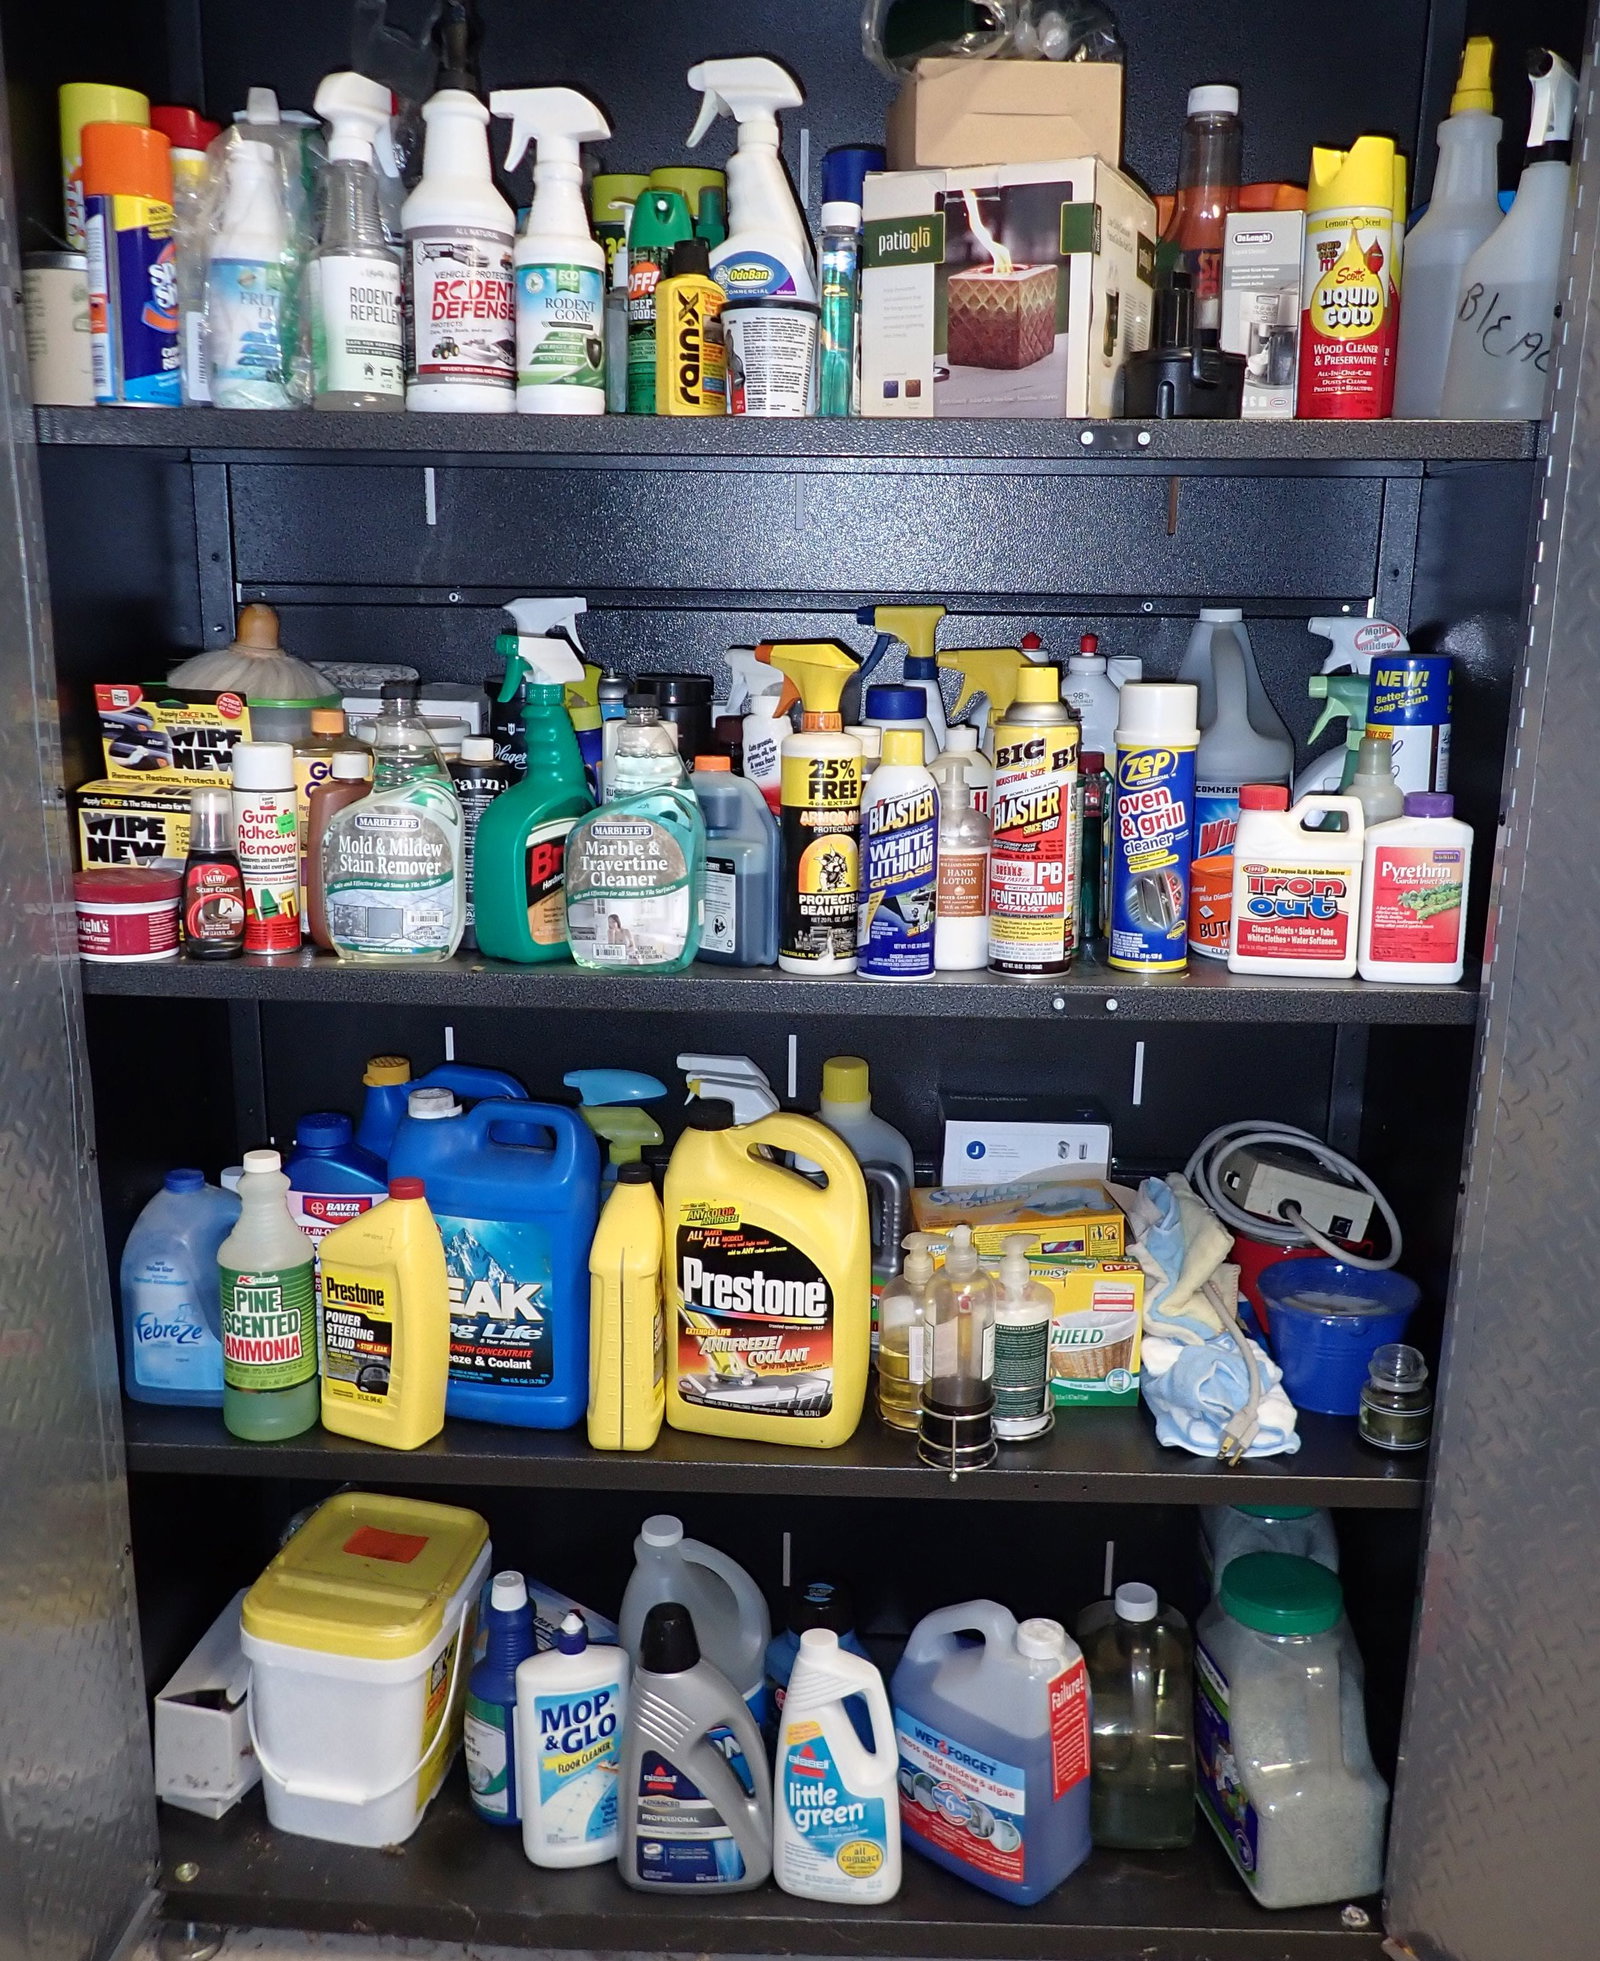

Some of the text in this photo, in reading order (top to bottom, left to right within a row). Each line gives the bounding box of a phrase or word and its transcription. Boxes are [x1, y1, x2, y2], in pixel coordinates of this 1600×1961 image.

[1325, 218, 1381, 229] Lemon Scent
[470, 229, 499, 240] NATURAL
[435, 270, 470, 279] VEHICLE
[729, 268, 768, 281] OdoBan
[350, 286, 393, 309] RODENT
[433, 280, 515, 301] RODENT
[1318, 287, 1379, 308] LIQUID
[431, 300, 516, 322] DEFENSE
[545, 297, 596, 312] RODENT
[630, 300, 653, 311] DEEP
[555, 310, 591, 323] GONE
[1324, 308, 1373, 328] GOLD
[1314, 356, 1322, 366] &
[1365, 627, 1387, 636] Mold
[1375, 670, 1430, 687] NEW!
[1374, 695, 1429, 714] Soap Scum
[1376, 688, 1422, 705] Better on
[166, 726, 243, 749] WIPE
[172, 748, 234, 771] NEW
[996, 738, 1045, 770] BIG
[809, 758, 855, 779] 25%
[1031, 767, 1046, 778] SIZE
[111, 772, 143, 781] Renews,
[146, 774, 181, 784] Restores,
[184, 777, 215, 785] Protects
[809, 780, 857, 800] FREE
[83, 797, 100, 806] Apply
[100, 799, 122, 807] ONCE
[157, 802, 172, 810] Lasts
[1119, 789, 1168, 815] oven
[243, 809, 277, 824] Gum
[359, 817, 417, 828] MARBLELIFE
[1140, 806, 1184, 838] grill
[81, 812, 167, 841] WIPE
[594, 825, 650, 836] MARBLELIFE
[1121, 819, 1135, 838] &
[87, 836, 166, 866] NEW
[240, 840, 296, 855] Remover
[339, 836, 443, 857] Mold & Mildew
[585, 841, 661, 856] Marble &
[869, 828, 934, 861] WHITE
[1125, 834, 1172, 854] cleaner
[340, 854, 441, 875] Stain Remover
[580, 855, 668, 871] Travertine
[869, 845, 933, 880] LITHIUM
[205, 875, 224, 884] KIWI
[590, 872, 657, 887] Cleaner
[869, 863, 932, 889] GREASE
[947, 869, 973, 877] HAND
[1037, 862, 1062, 884] PB
[1382, 862, 1451, 882] Pyrethrin
[943, 877, 977, 885] LOTION
[799, 893, 855, 905] PROTECTS
[991, 889, 1063, 906] PENETRATING
[997, 904, 1048, 912] CATALYST
[1247, 895, 1338, 920] out
[1252, 925, 1334, 936] Cleans Toilets Sinks Tubs
[1247, 934, 1338, 945] White Clothes Water Softeners
[326, 1202, 360, 1212] BAYER
[687, 1209, 705, 1221] ANY
[707, 1207, 735, 1217] COLOR
[701, 1214, 739, 1225] ANTIFREEZE
[687, 1231, 703, 1242] ALL
[703, 1237, 720, 1248] ALL
[326, 1276, 385, 1306] Prestone
[683, 1256, 826, 1317] Prestone
[236, 1289, 280, 1313] PINE
[224, 1311, 300, 1338] SCENTED
[325, 1310, 361, 1327] POWER
[327, 1322, 374, 1341] STEERING
[482, 1324, 542, 1340] Life
[717, 1328, 731, 1336] LIFE
[225, 1335, 301, 1362] AMMONIA
[327, 1335, 355, 1349] FLUID
[360, 1342, 388, 1353] STOP LEAK
[476, 1346, 533, 1358] CONCENTRATE
[748, 1347, 810, 1369] COOLANT
[475, 1356, 531, 1369] & Coolant
[1052, 1669, 1085, 1712] Failure!
[539, 1690, 610, 1735] MOP
[544, 1733, 559, 1751] &
[561, 1712, 617, 1755] GLO
[557, 1741, 611, 1774] FLOOR CLEANER
[901, 1736, 921, 1751] moss
[923, 1751, 943, 1766] mold
[945, 1762, 977, 1785] mildew
[987, 1783, 1016, 1799] algae
[790, 1782, 838, 1806] little
[642, 1814, 699, 1823] PROFESSIONAL
[795, 1802, 864, 1833] green
[842, 1853, 880, 1864] compact
[854, 1847, 866, 1855] all
